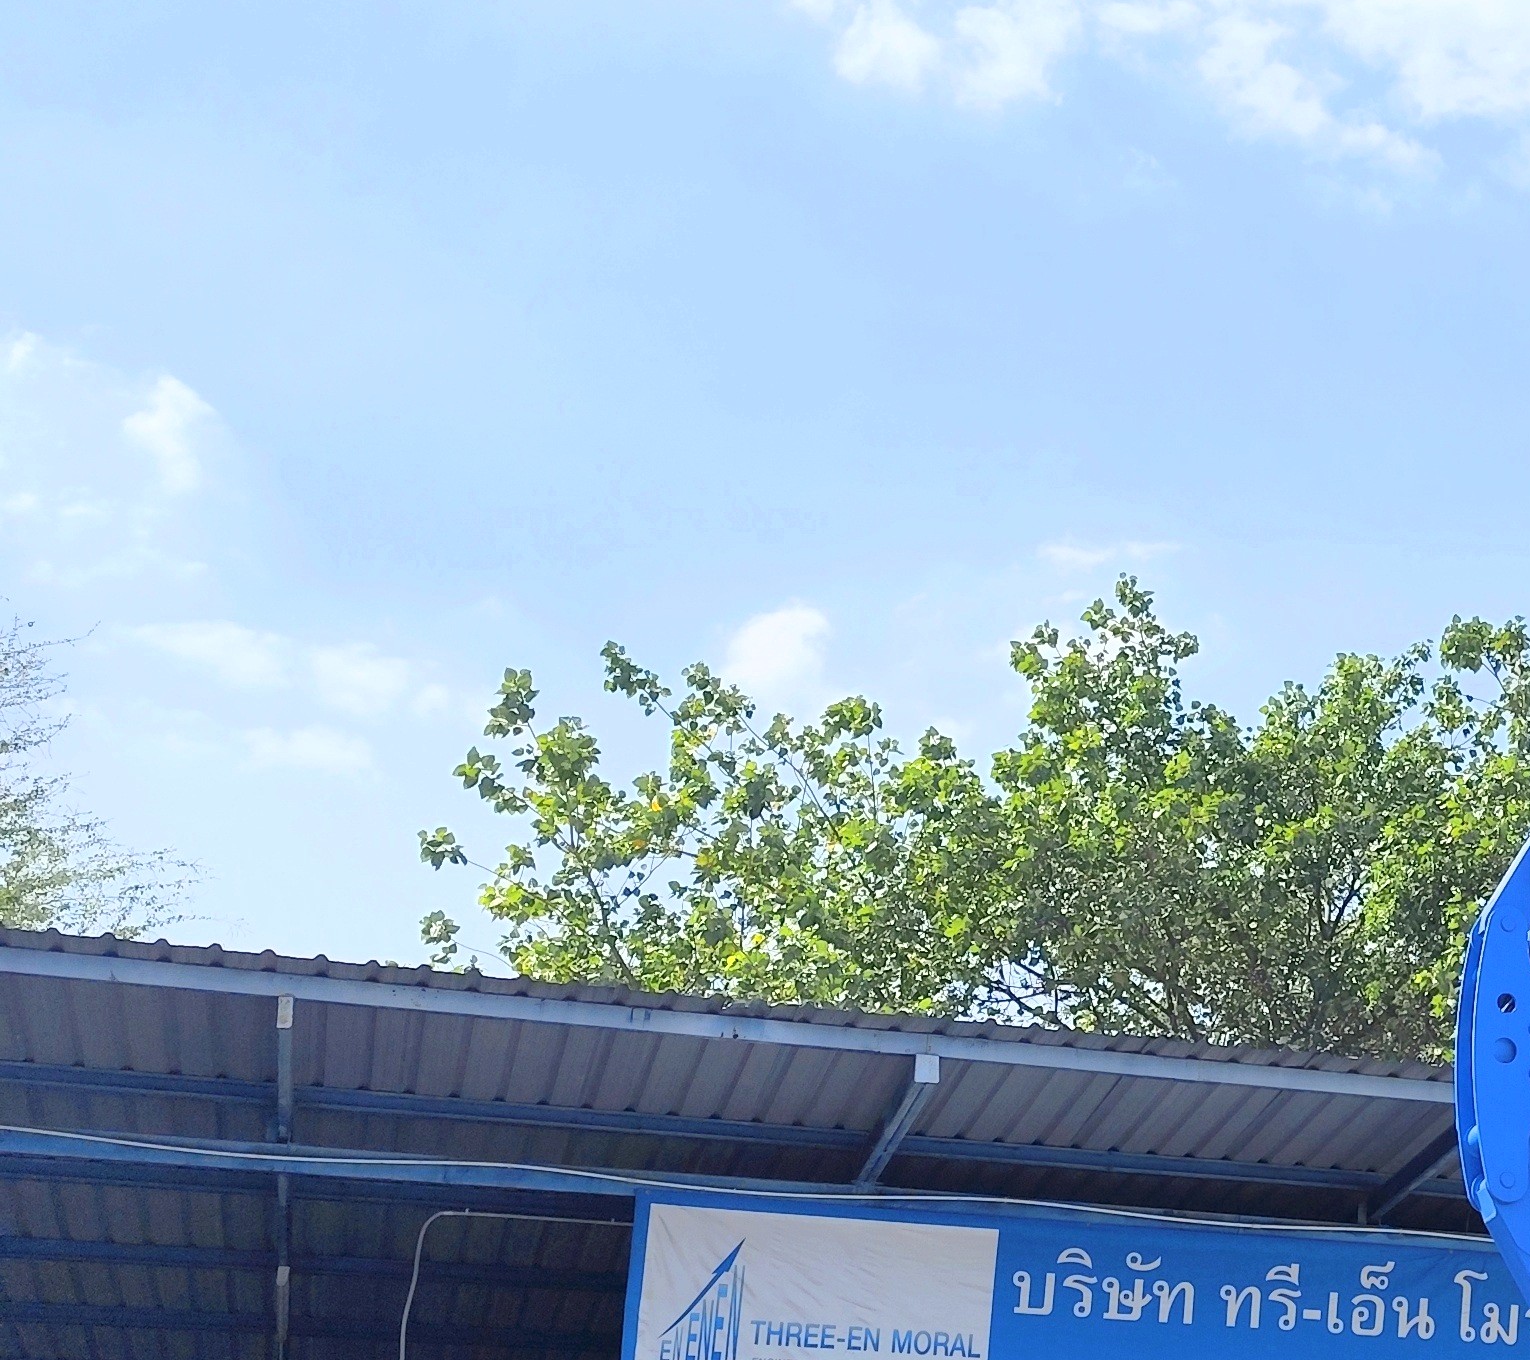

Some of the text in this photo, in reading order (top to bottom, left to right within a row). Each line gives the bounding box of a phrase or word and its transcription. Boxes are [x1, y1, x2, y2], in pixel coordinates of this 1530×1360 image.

[1012, 1246, 1195, 1325] บริษัท
[1219, 1260, 1437, 1341] ทรี-เอ็น
[750, 1319, 982, 1359] THREE-EN MORAL
